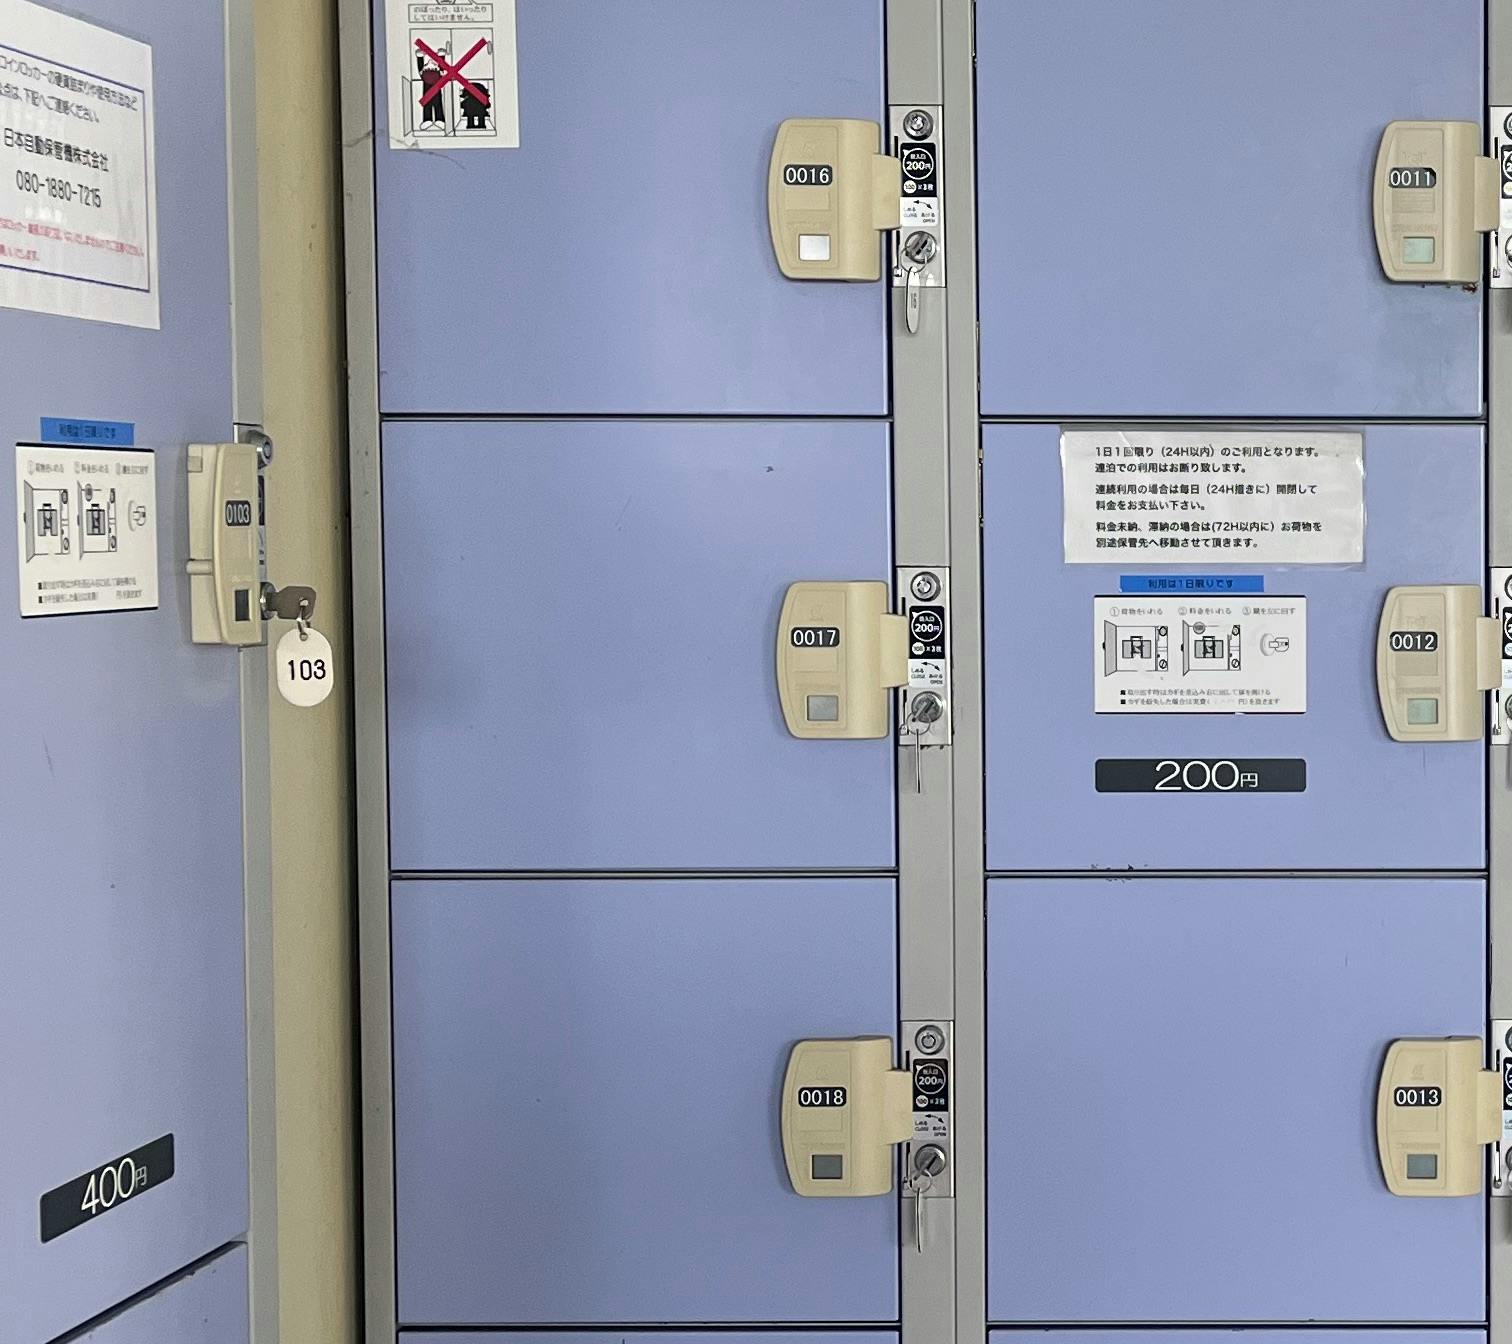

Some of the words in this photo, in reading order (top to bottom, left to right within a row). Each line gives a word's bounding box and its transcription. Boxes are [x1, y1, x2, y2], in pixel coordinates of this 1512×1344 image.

[786, 167, 829, 184] 0016
[1390, 170, 1431, 187] 0011
[16, 169, 101, 208] 080-1880-7215
[226, 503, 250, 524] 0103
[1096, 500, 1205, 511] 料金をお支払い下さい。
[793, 630, 837, 647] 0017
[1392, 633, 1435, 650] 0012
[288, 659, 326, 681] 103
[1155, 760, 1258, 791] 200円
[801, 1089, 843, 1105] 0018
[1396, 1089, 1439, 1105] 0013
[81, 1158, 147, 1214] 400円
